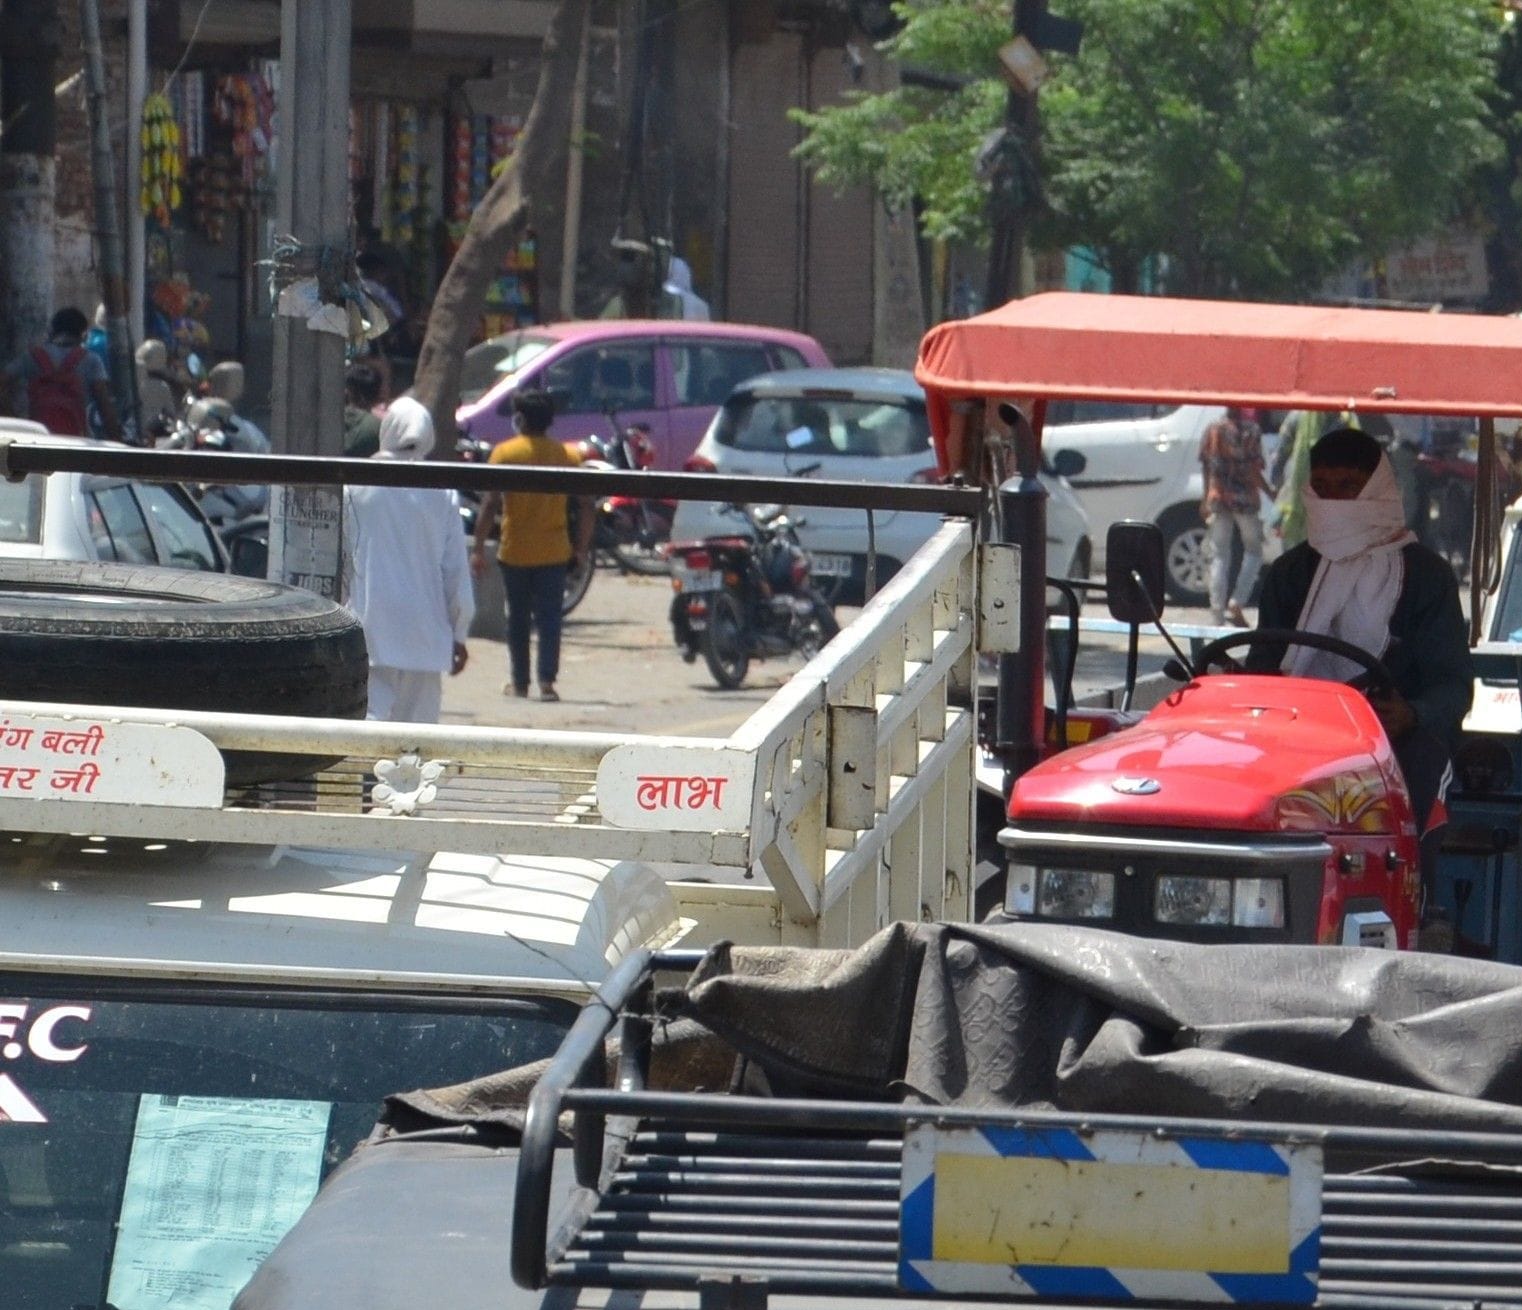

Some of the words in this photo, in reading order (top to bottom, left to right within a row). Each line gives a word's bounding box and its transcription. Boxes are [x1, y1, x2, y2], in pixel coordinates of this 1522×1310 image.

[41, 725, 104, 756] बली
[50, 762, 101, 793] जी
[636, 774, 728, 811] लाभ
